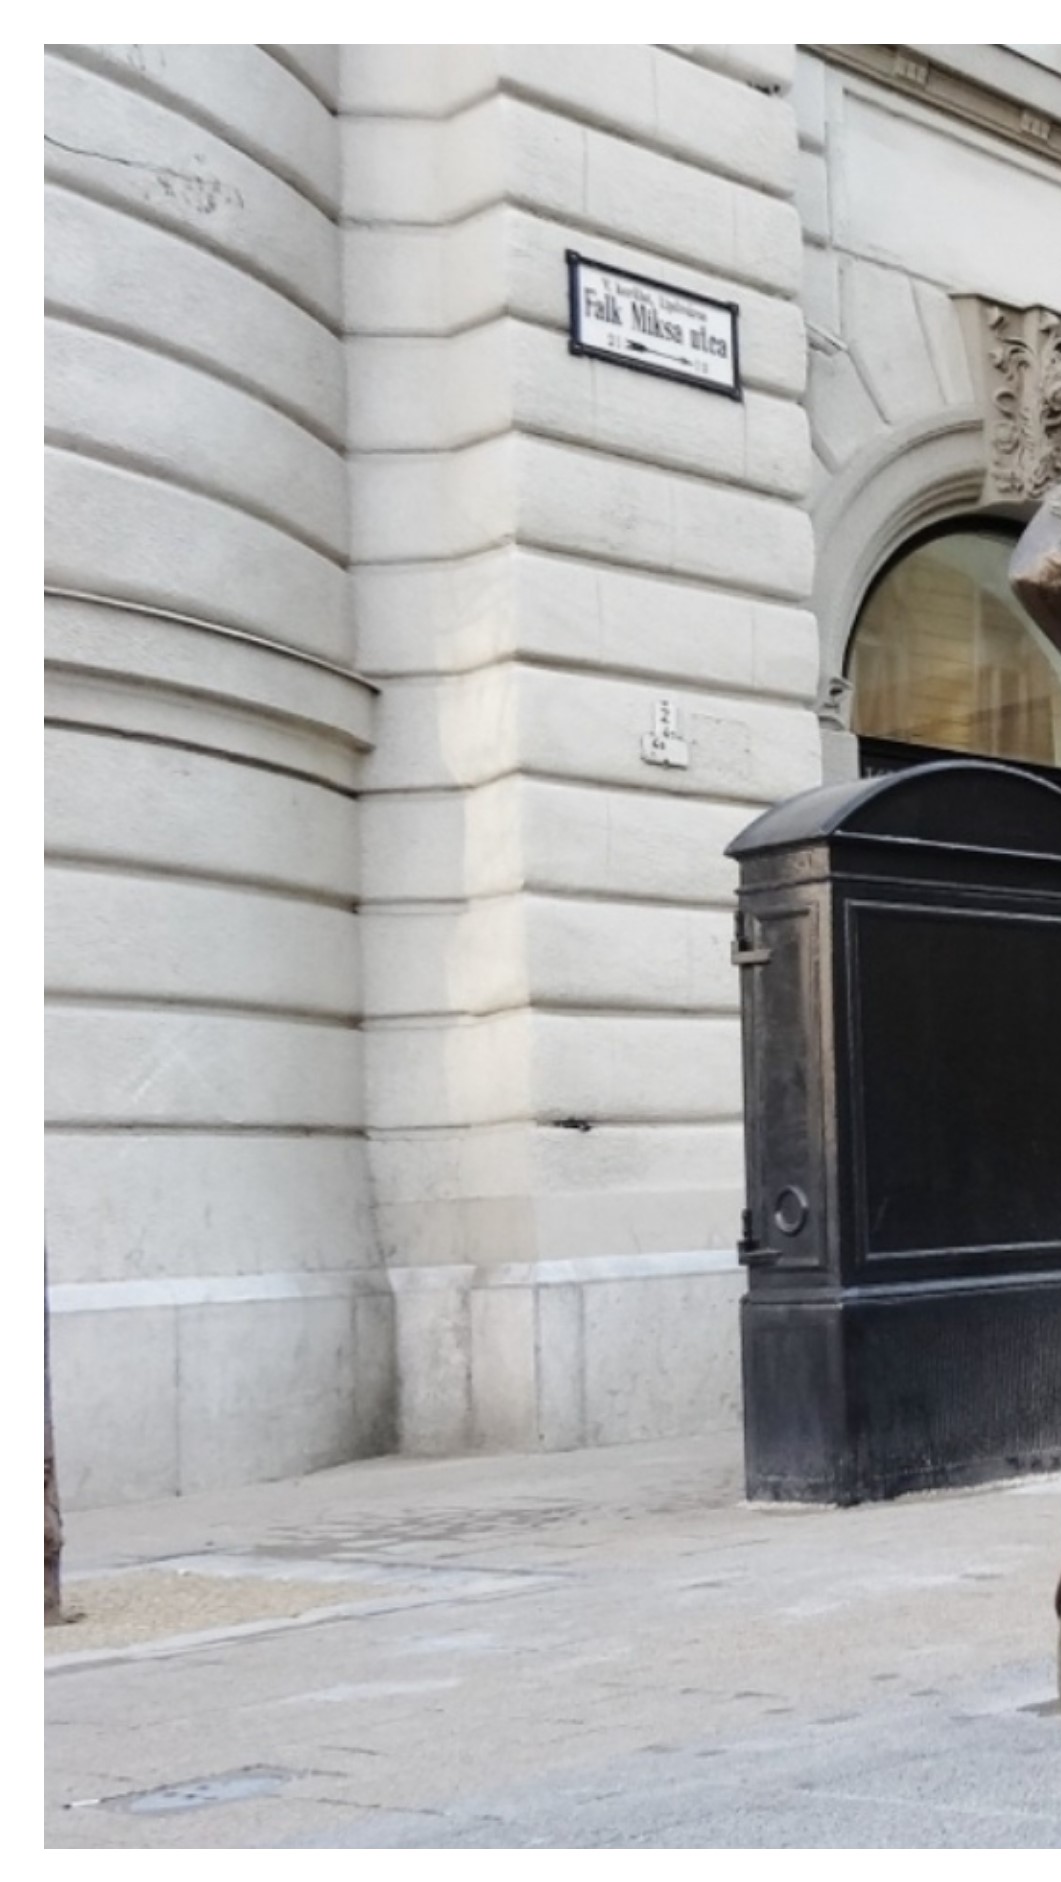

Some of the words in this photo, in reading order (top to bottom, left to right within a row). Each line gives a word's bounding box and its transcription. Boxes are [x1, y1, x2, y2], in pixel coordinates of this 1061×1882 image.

[584, 287, 622, 326] Falk
[632, 301, 684, 345] Miksa
[690, 325, 728, 359] utca
